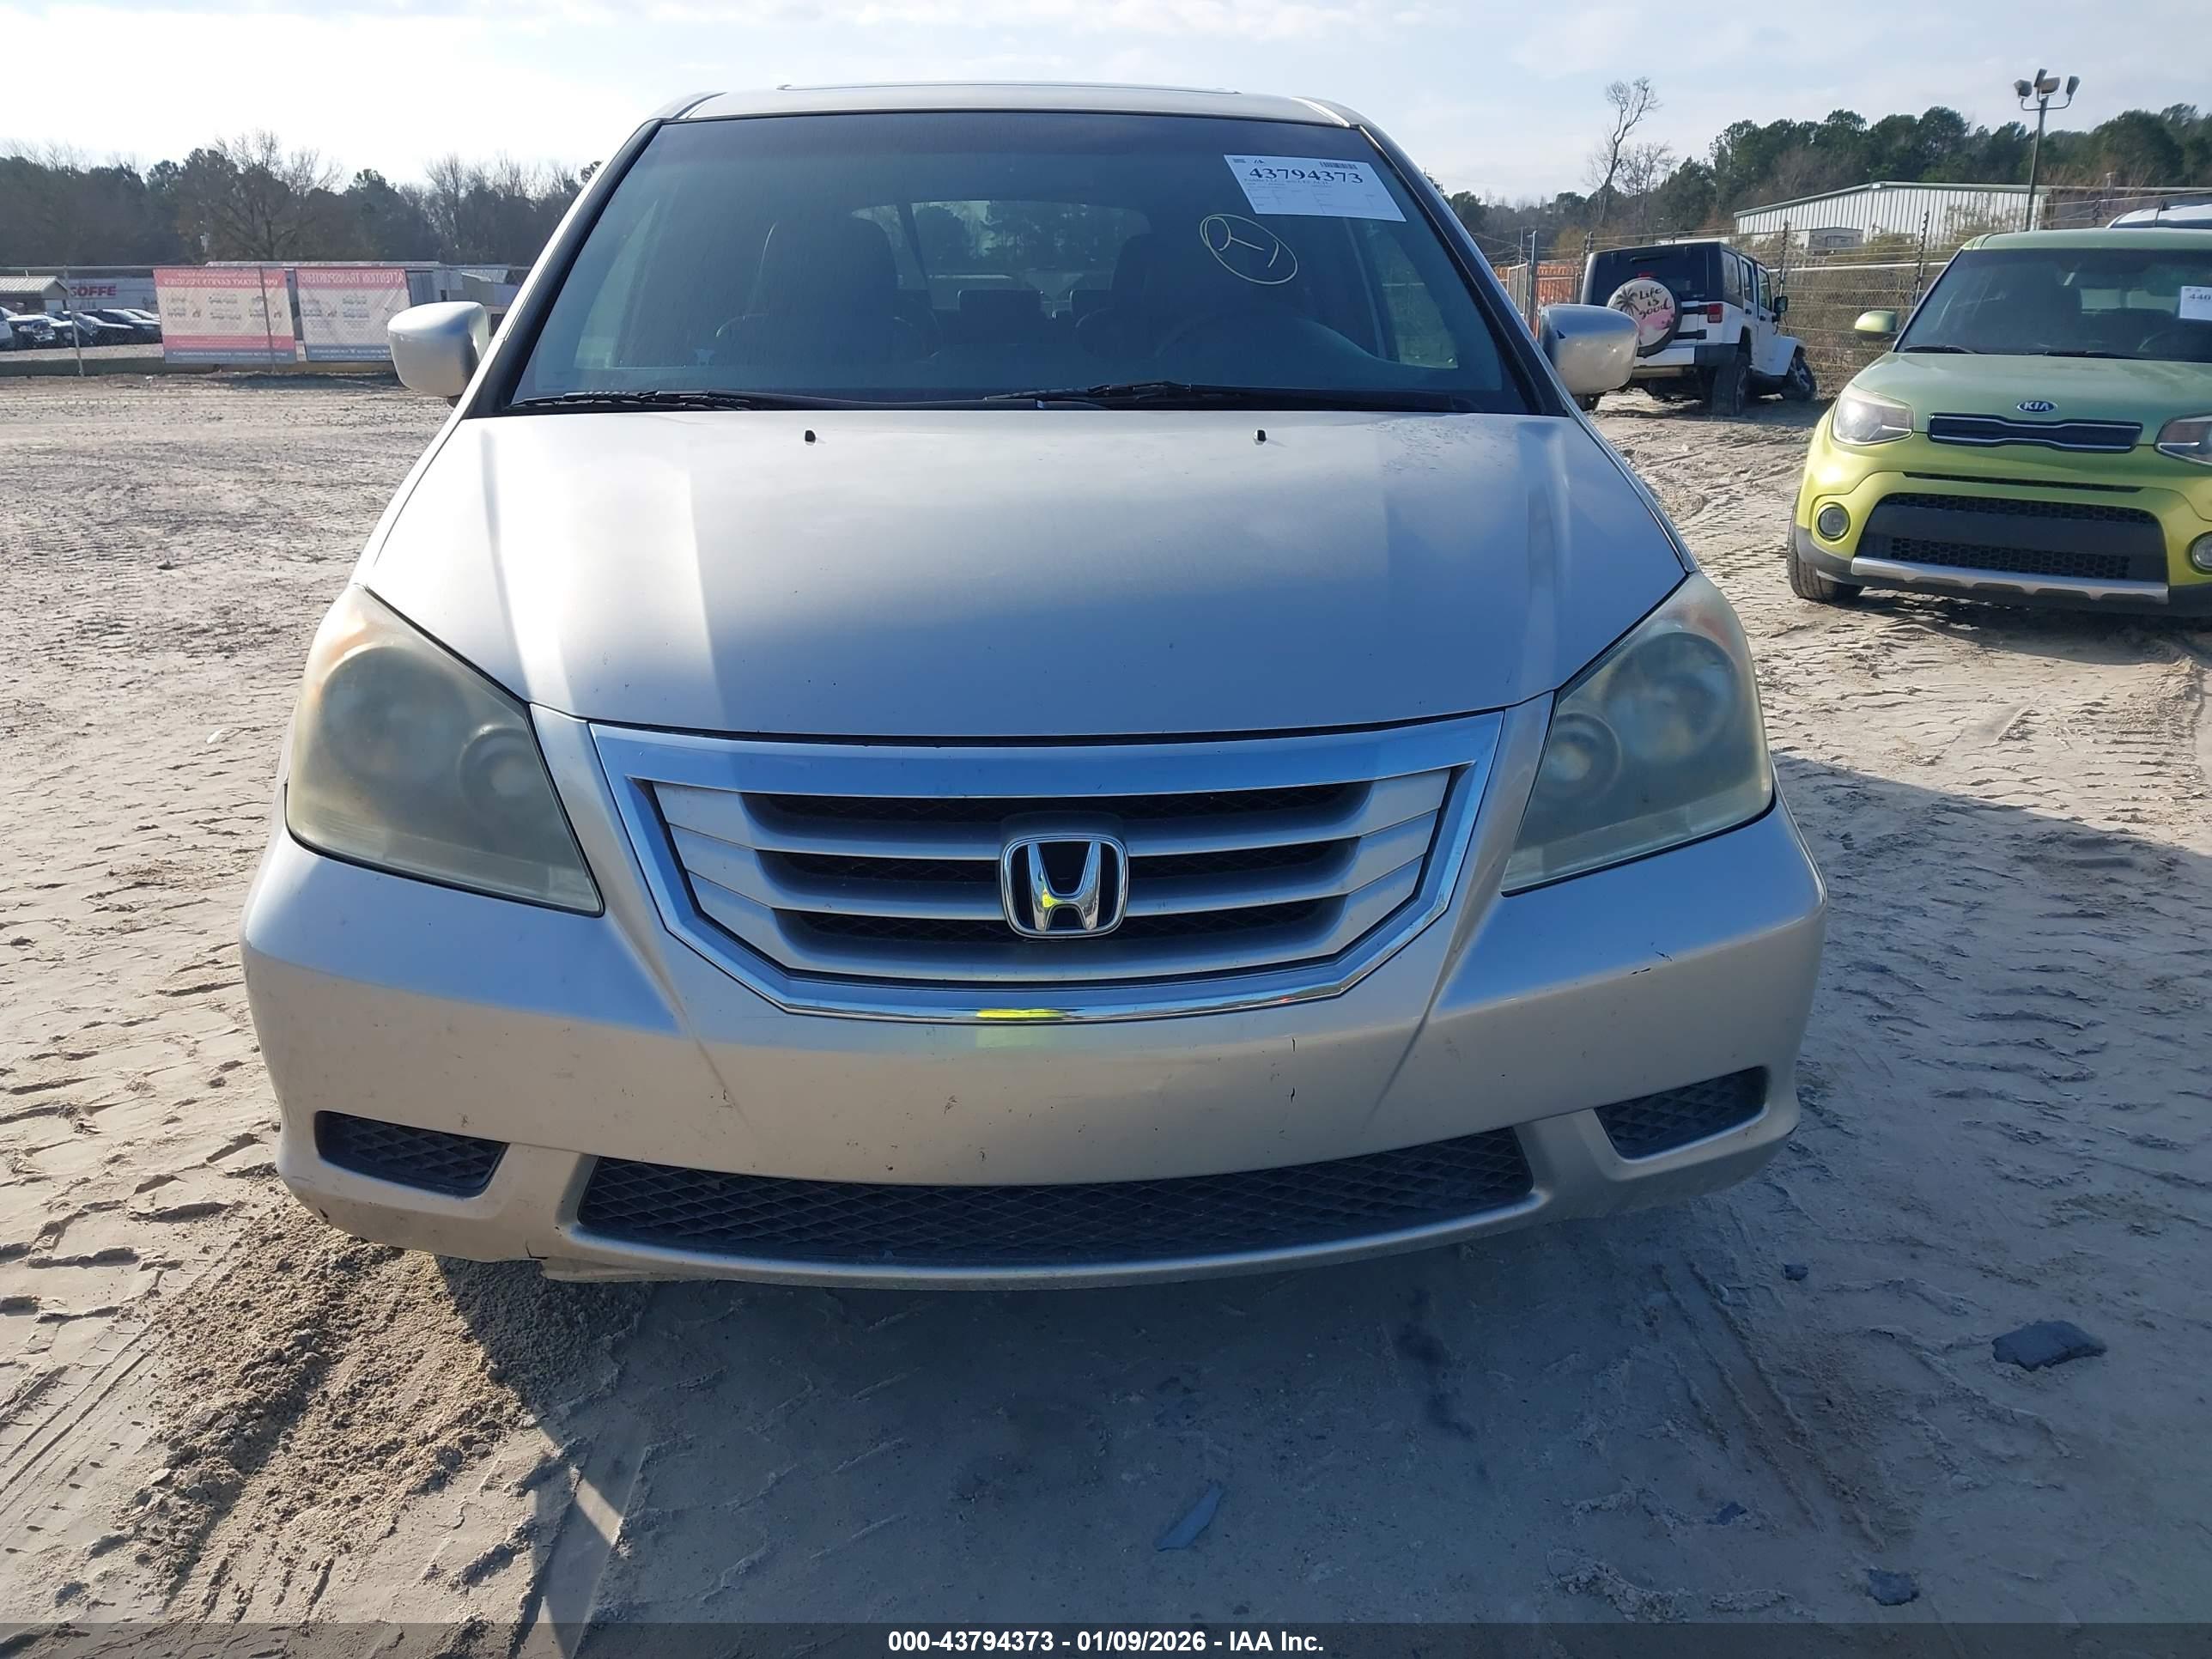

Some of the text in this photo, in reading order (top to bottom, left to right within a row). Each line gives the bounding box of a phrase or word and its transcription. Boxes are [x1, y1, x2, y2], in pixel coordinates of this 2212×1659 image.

[1249, 167, 1364, 185] 43794373
[70, 284, 117, 297] SOFFE
[2023, 401, 2050, 410] KIA
